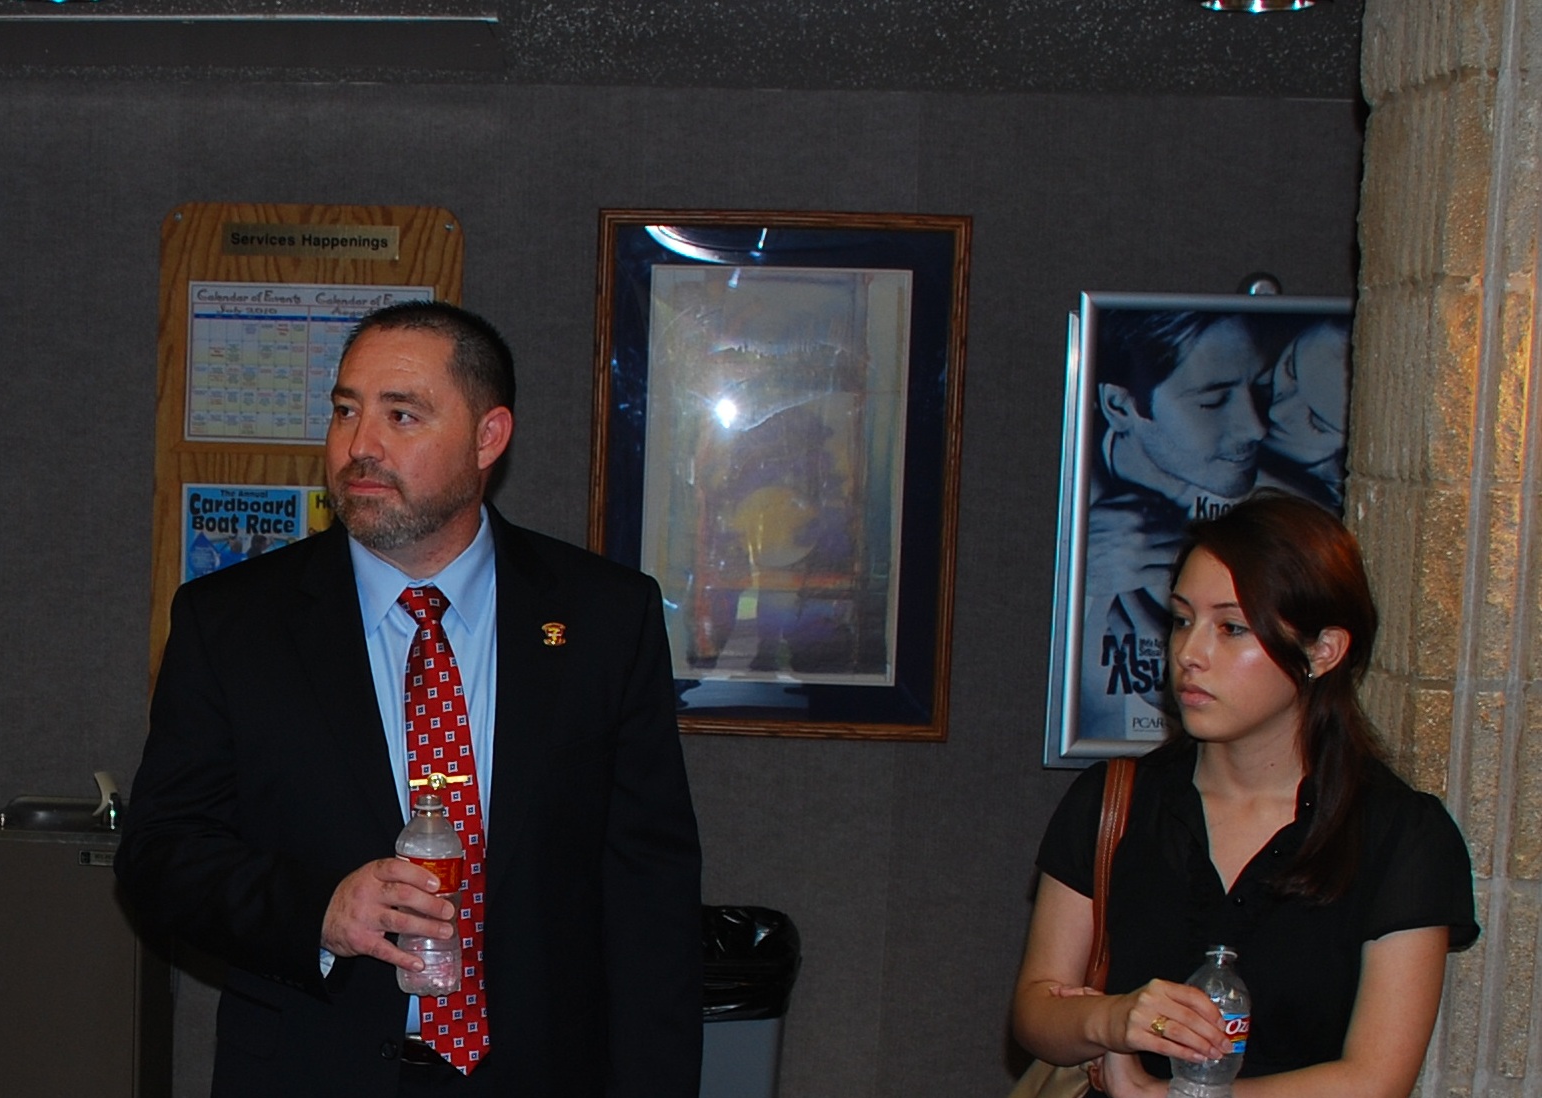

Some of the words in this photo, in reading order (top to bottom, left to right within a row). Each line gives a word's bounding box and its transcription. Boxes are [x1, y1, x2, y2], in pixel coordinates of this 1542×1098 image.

[230, 231, 296, 247] Services
[301, 233, 388, 251] Happenings
[197, 288, 249, 303] Calendar
[251, 291, 264, 303] of
[264, 289, 302, 304] Events
[220, 489, 235, 497] The
[238, 489, 269, 498] Annual
[189, 492, 297, 518] Cardboard
[192, 513, 240, 534] Boat
[245, 514, 296, 534] Race
